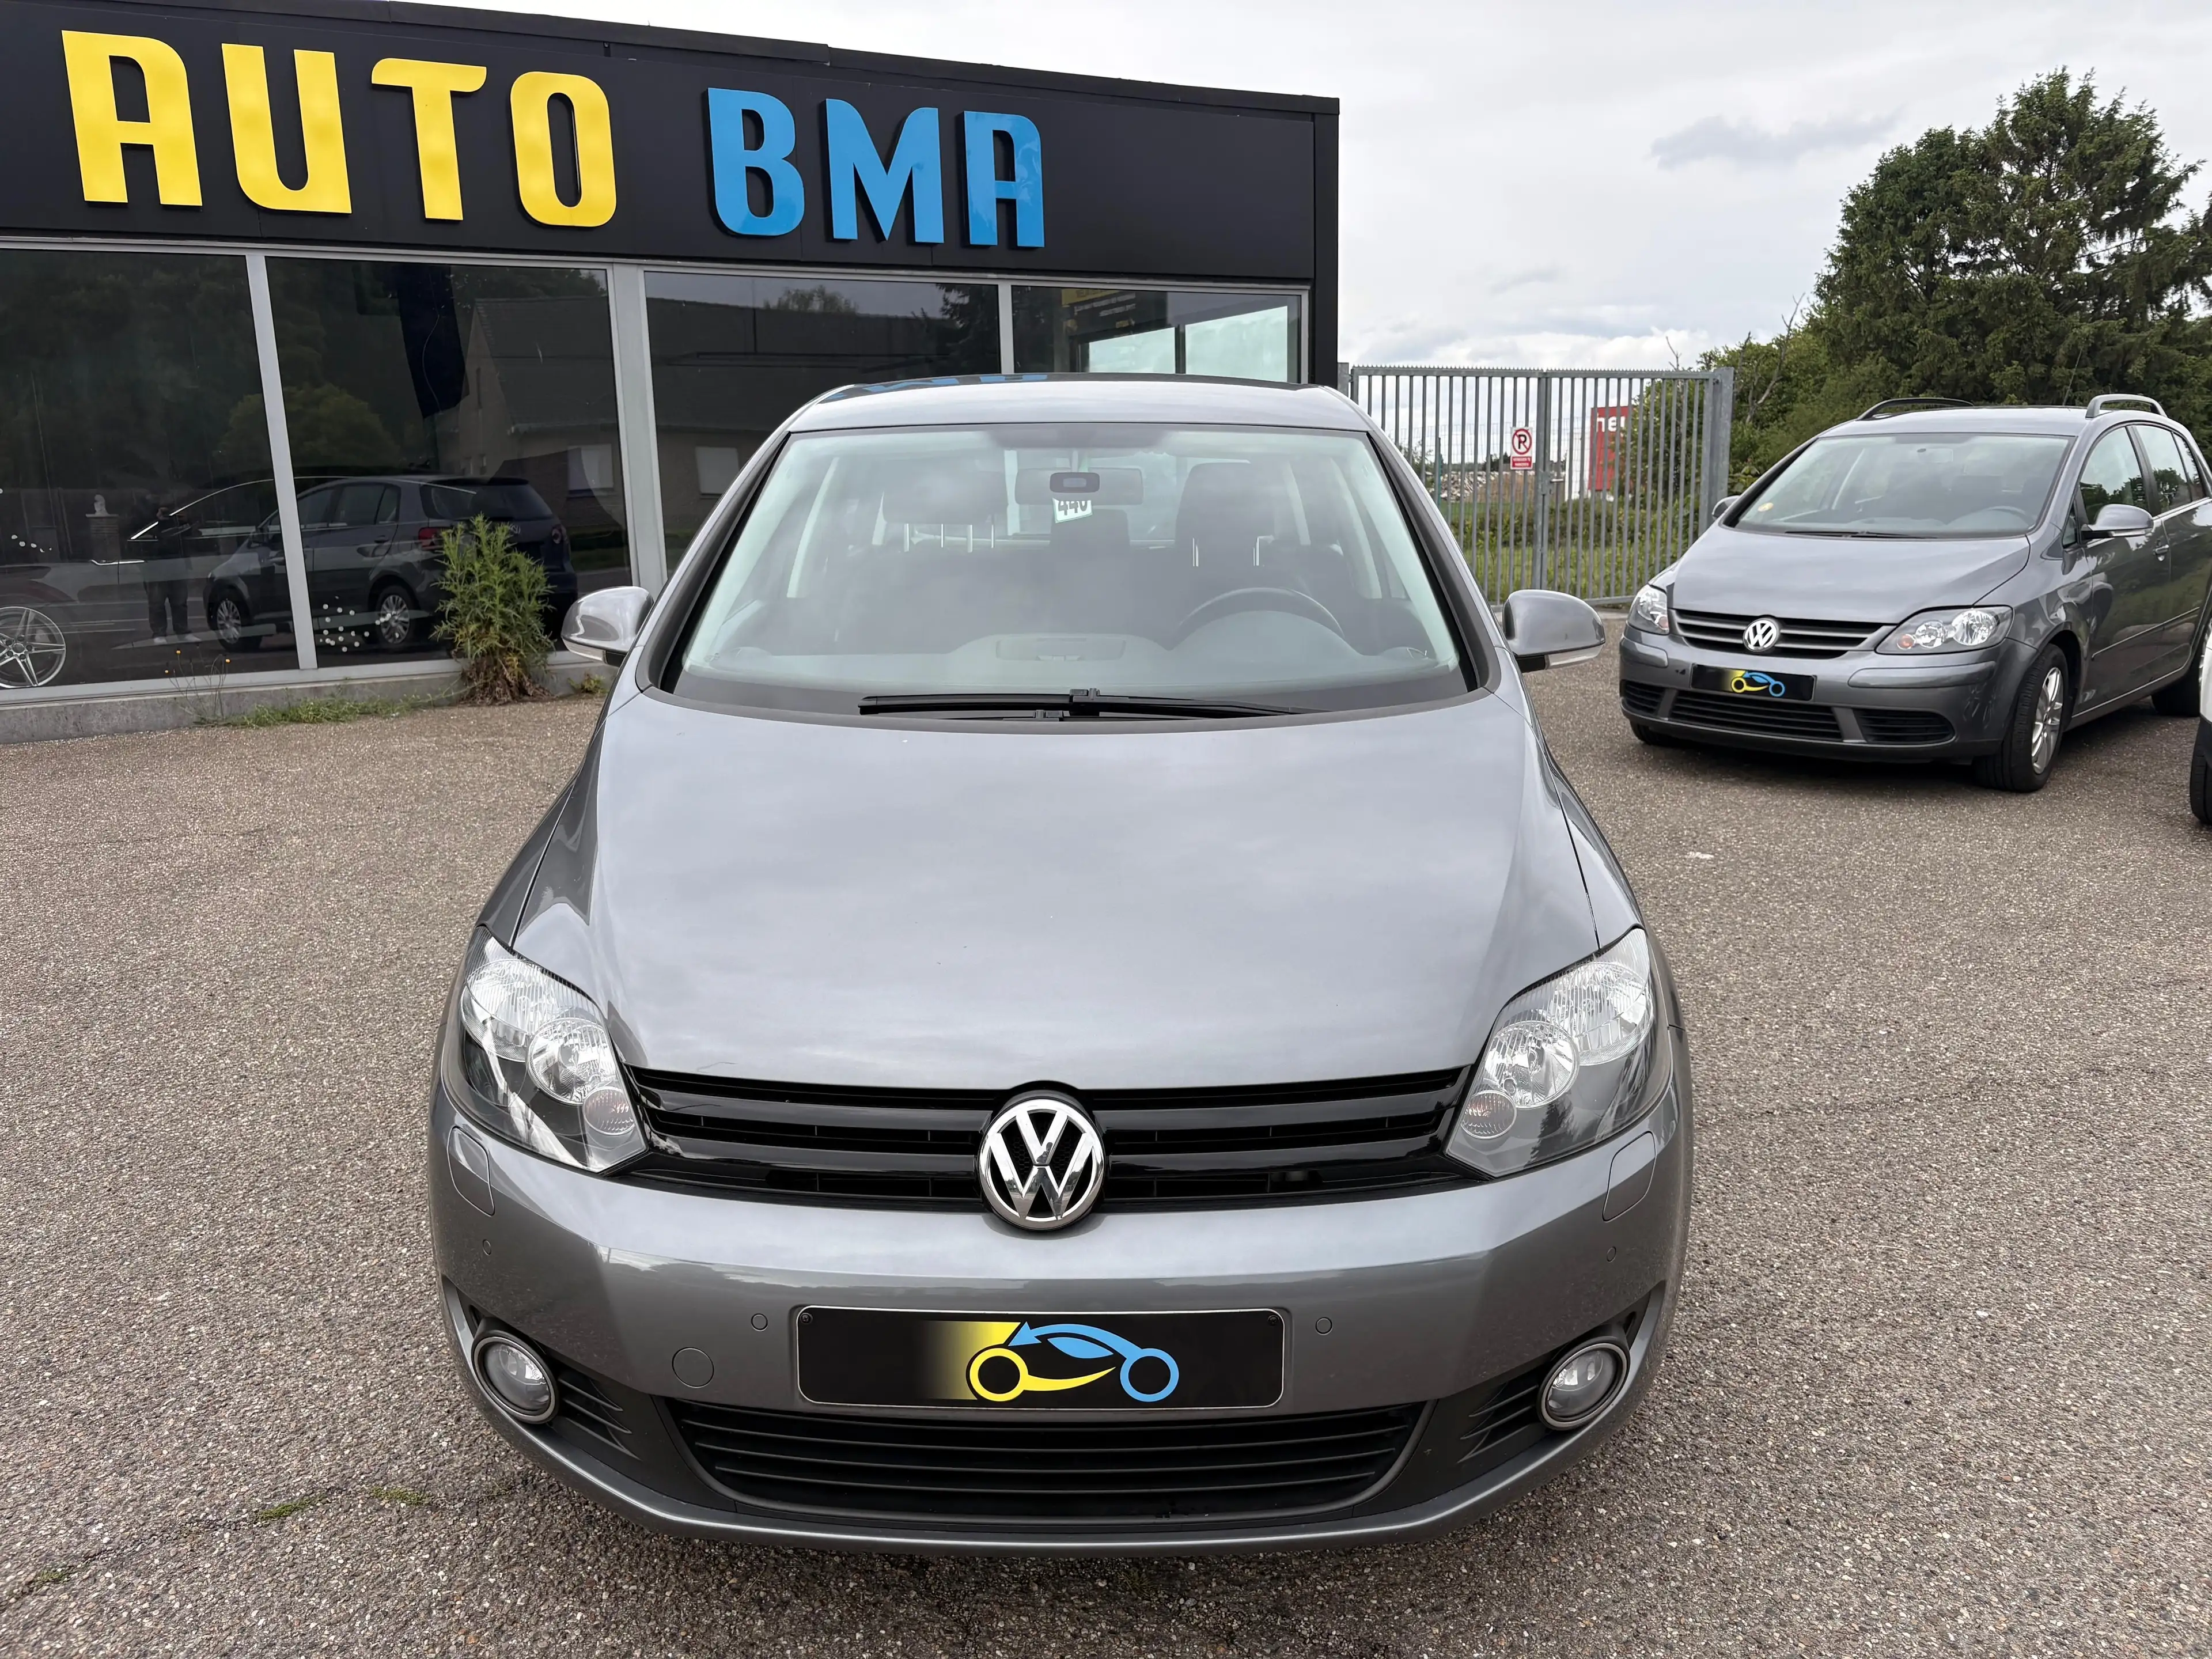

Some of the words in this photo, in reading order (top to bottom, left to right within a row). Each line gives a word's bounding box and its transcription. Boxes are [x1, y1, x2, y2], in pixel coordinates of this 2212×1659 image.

[62, 30, 617, 229] AUTO
[706, 87, 1045, 248] BMA
[1744, 620, 1777, 650] VW
[982, 1103, 1101, 1226] VW
